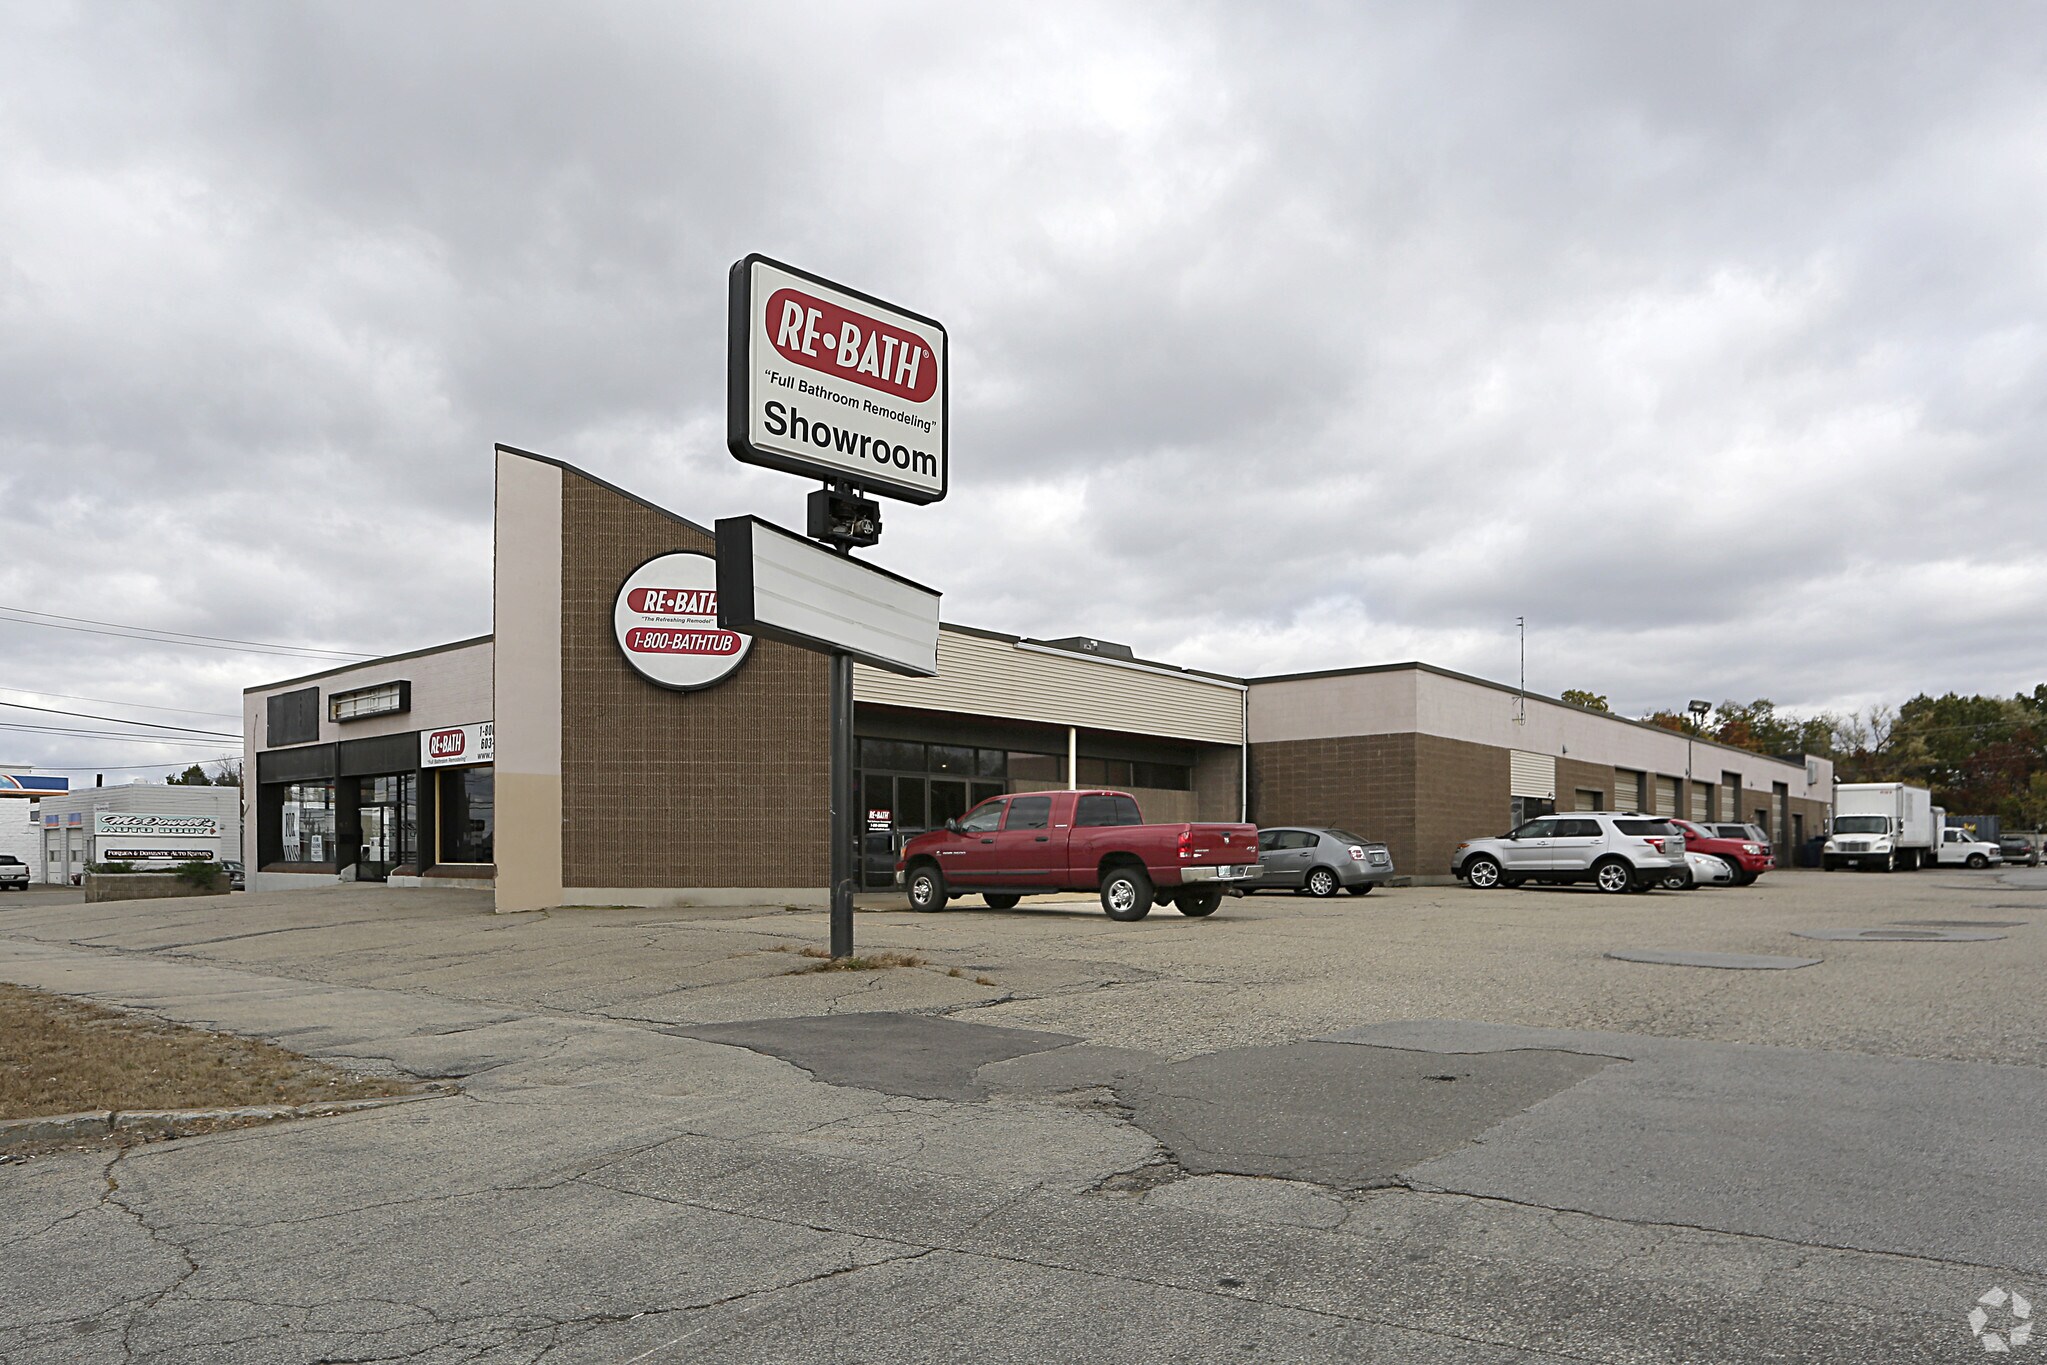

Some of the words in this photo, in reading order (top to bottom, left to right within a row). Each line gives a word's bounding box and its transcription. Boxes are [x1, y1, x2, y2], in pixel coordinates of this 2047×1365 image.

[798, 380, 860, 410] Bathroom
[763, 400, 937, 478] Showroom
[655, 616, 686, 624] Refreshing
[633, 631, 734, 651] 1-800-BATHTUB
[479, 724, 493, 737] 1-80
[101, 814, 216, 828] McDowell's
[158, 827, 208, 835] BODY
